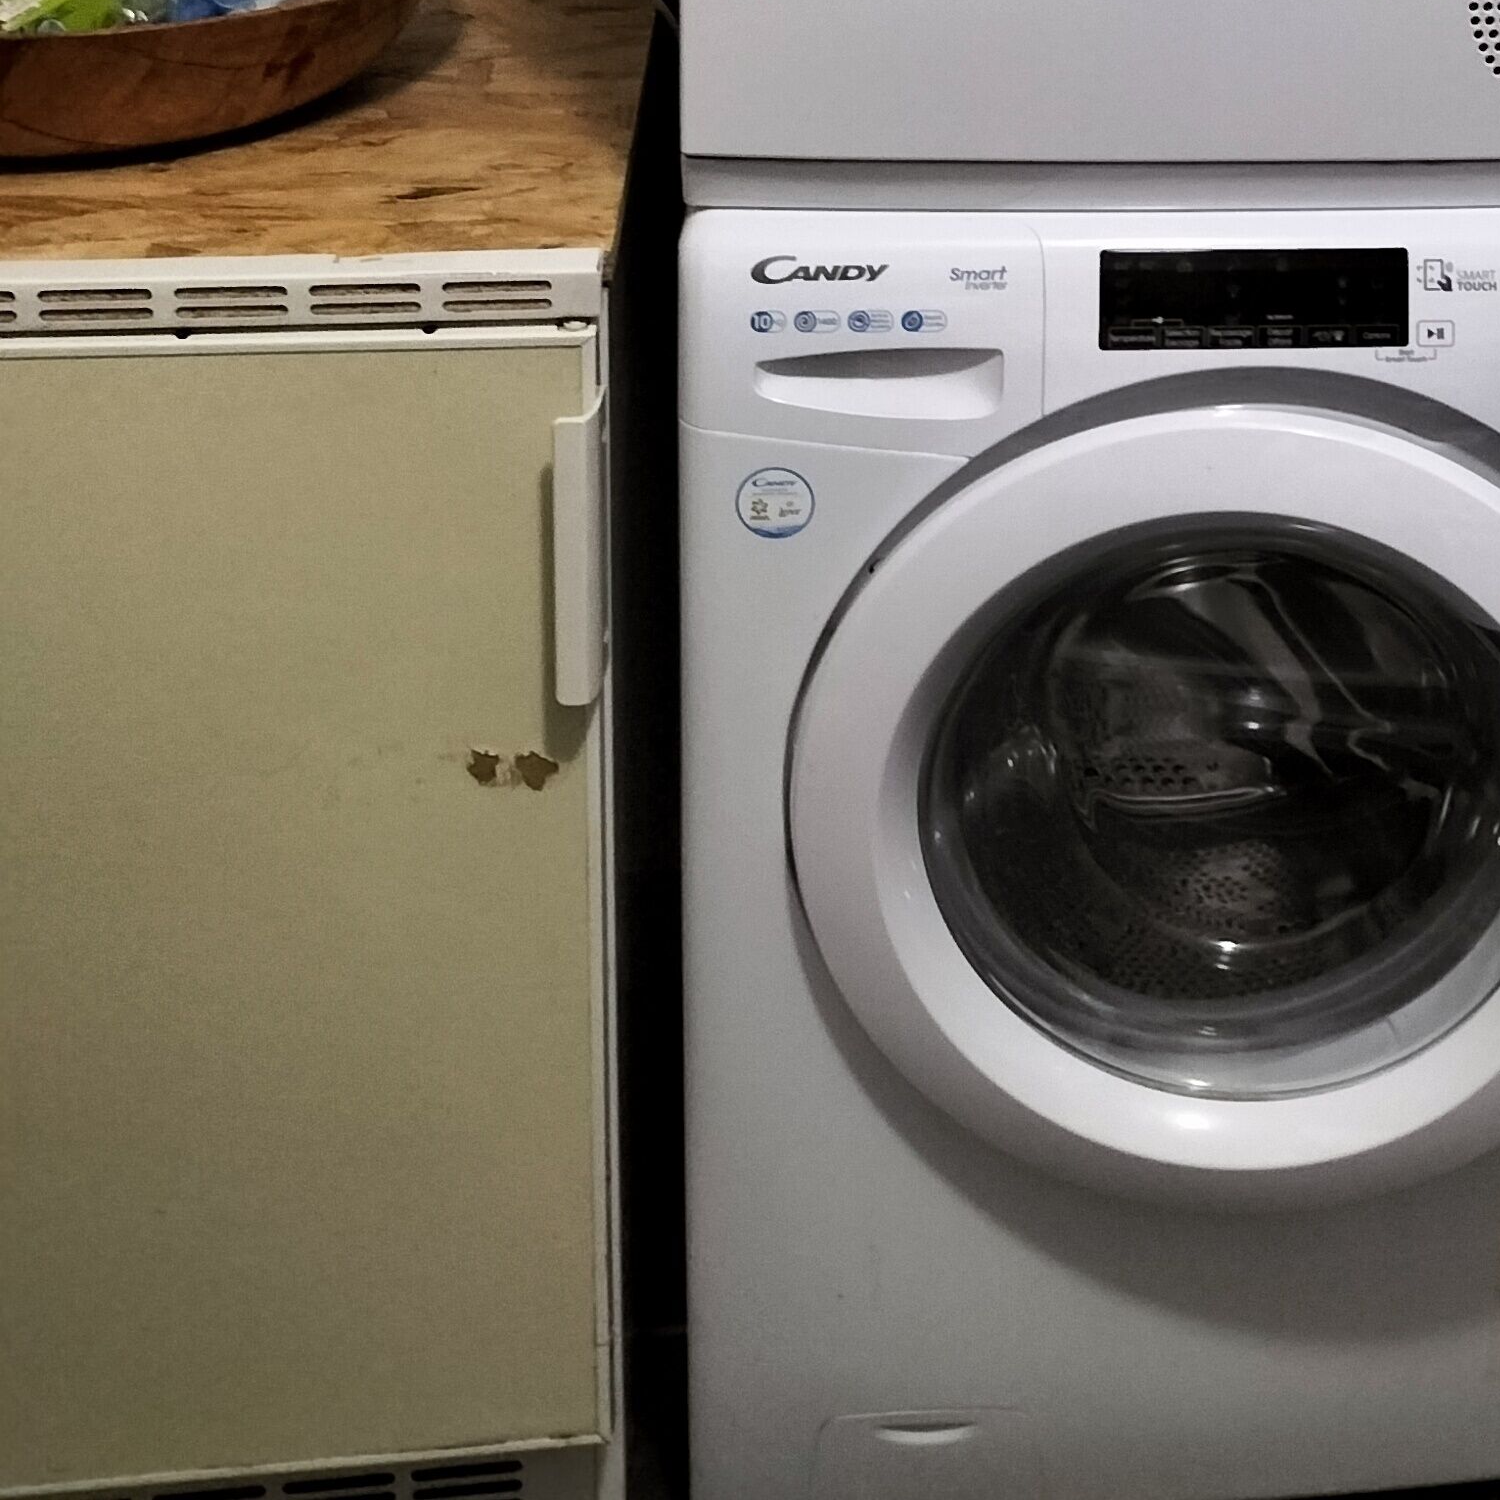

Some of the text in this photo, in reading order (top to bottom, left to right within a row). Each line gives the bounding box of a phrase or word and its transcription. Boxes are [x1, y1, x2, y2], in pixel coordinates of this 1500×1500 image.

[750, 255, 889, 285] CANDY
[949, 265, 1008, 281] Smart
[1456, 270, 1497, 281] SMART
[1457, 281, 1497, 291] TOUCH
